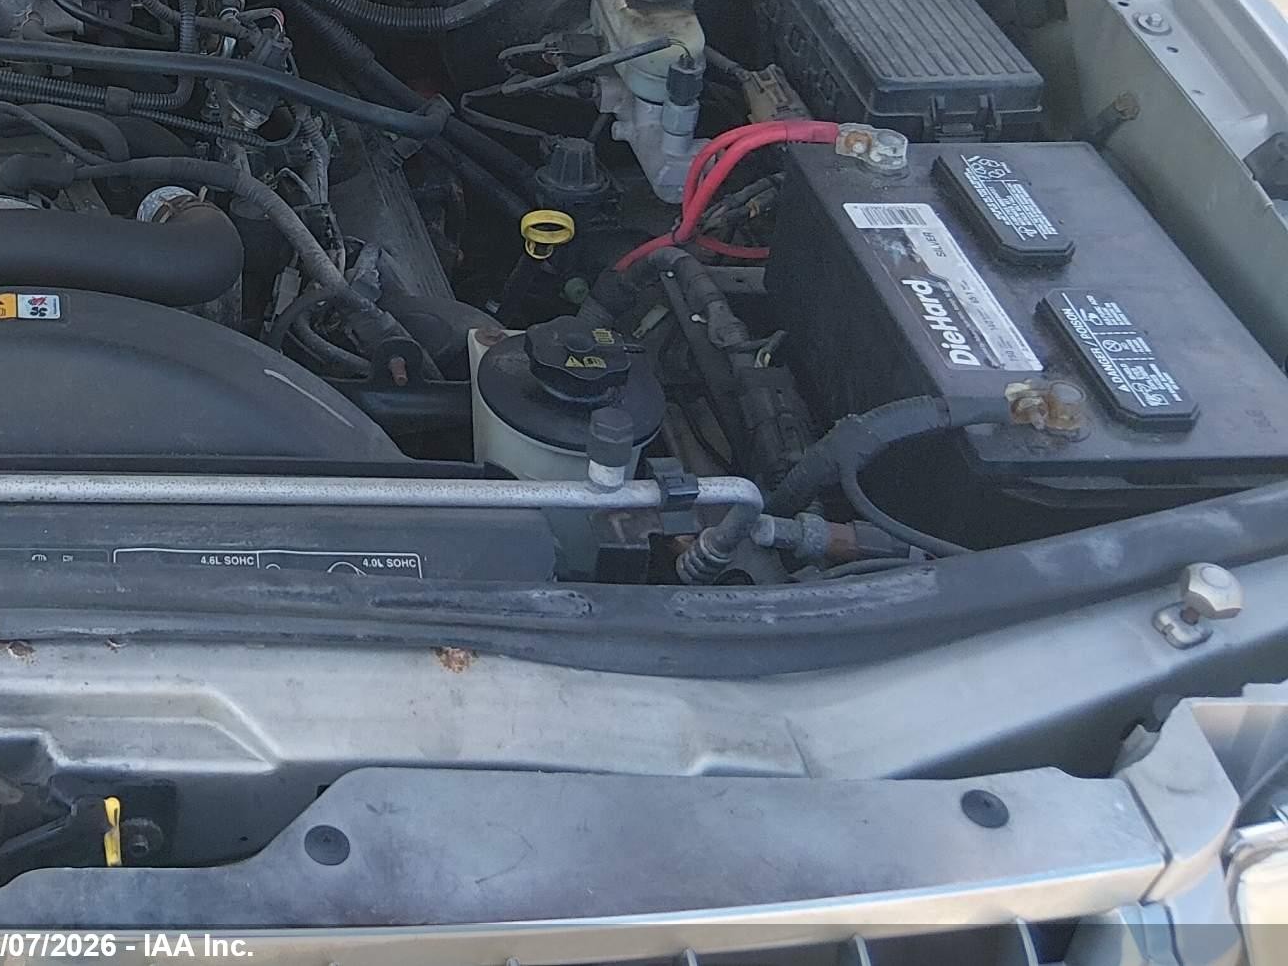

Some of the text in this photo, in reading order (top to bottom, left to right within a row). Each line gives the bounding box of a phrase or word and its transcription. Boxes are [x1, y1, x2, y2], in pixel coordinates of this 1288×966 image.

[922, 231, 947, 258] SILVER
[901, 279, 981, 367] DieHard
[1061, 308, 1093, 340] POISON
[1090, 347, 1124, 384] DANGER
[224, 555, 254, 566] SOHC
[362, 557, 417, 568] 4.0L SOHC
